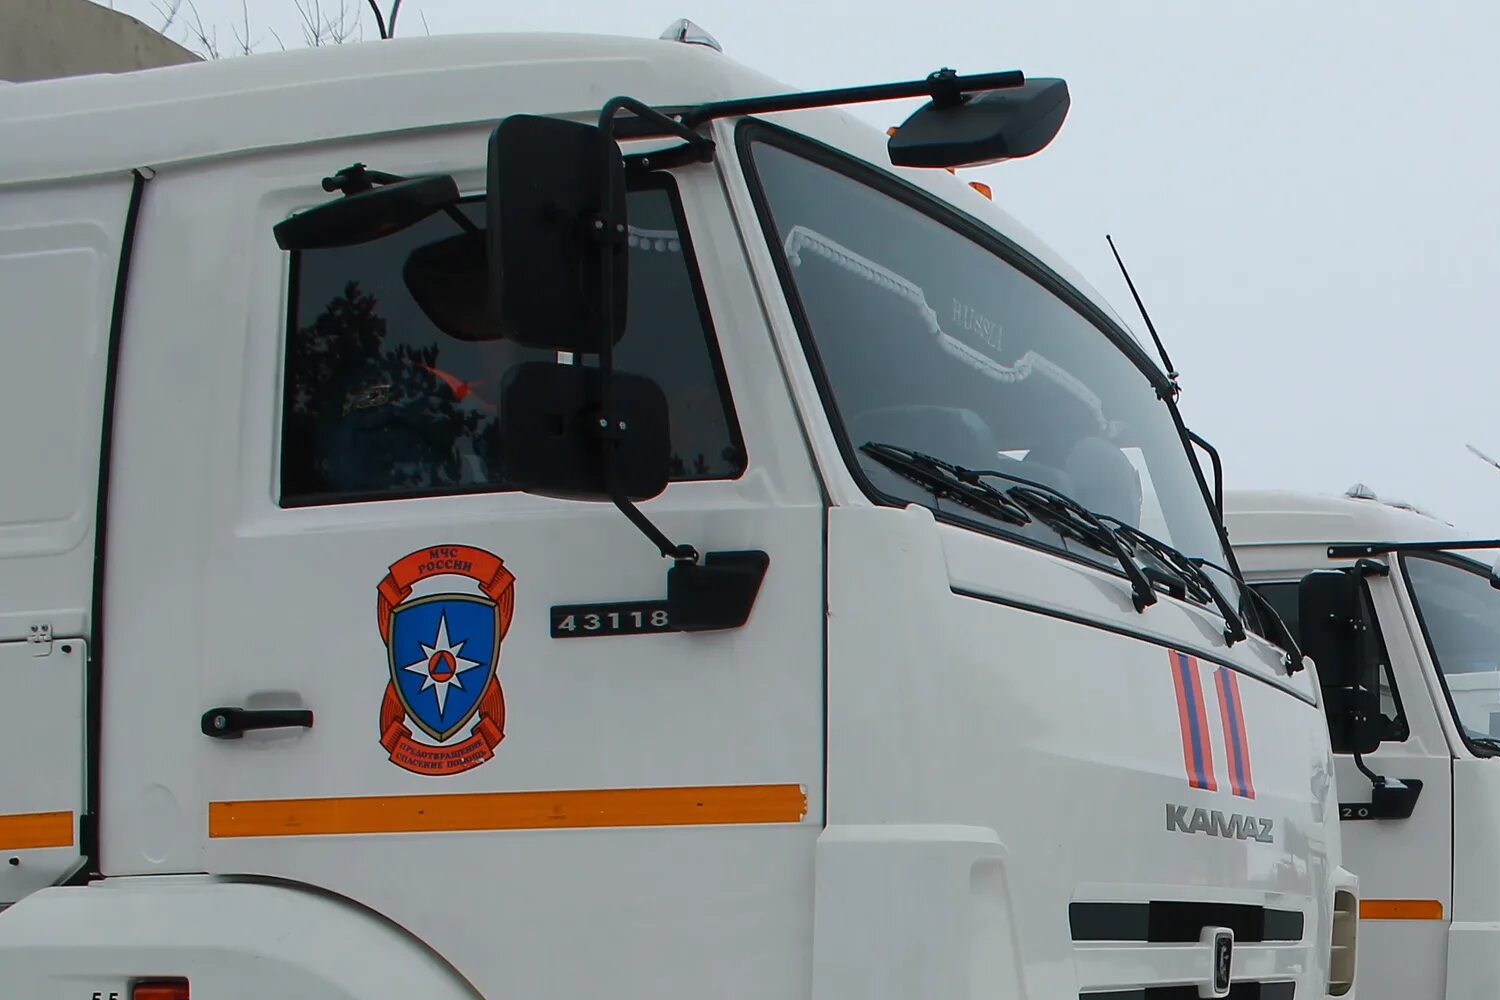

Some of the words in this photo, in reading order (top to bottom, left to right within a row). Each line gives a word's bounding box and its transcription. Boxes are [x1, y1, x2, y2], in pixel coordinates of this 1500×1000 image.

[429, 548, 458, 559] МЧС
[418, 560, 473, 574] РОССИИ
[558, 610, 668, 632] 43118
[1166, 803, 1274, 844] KAMAZ
